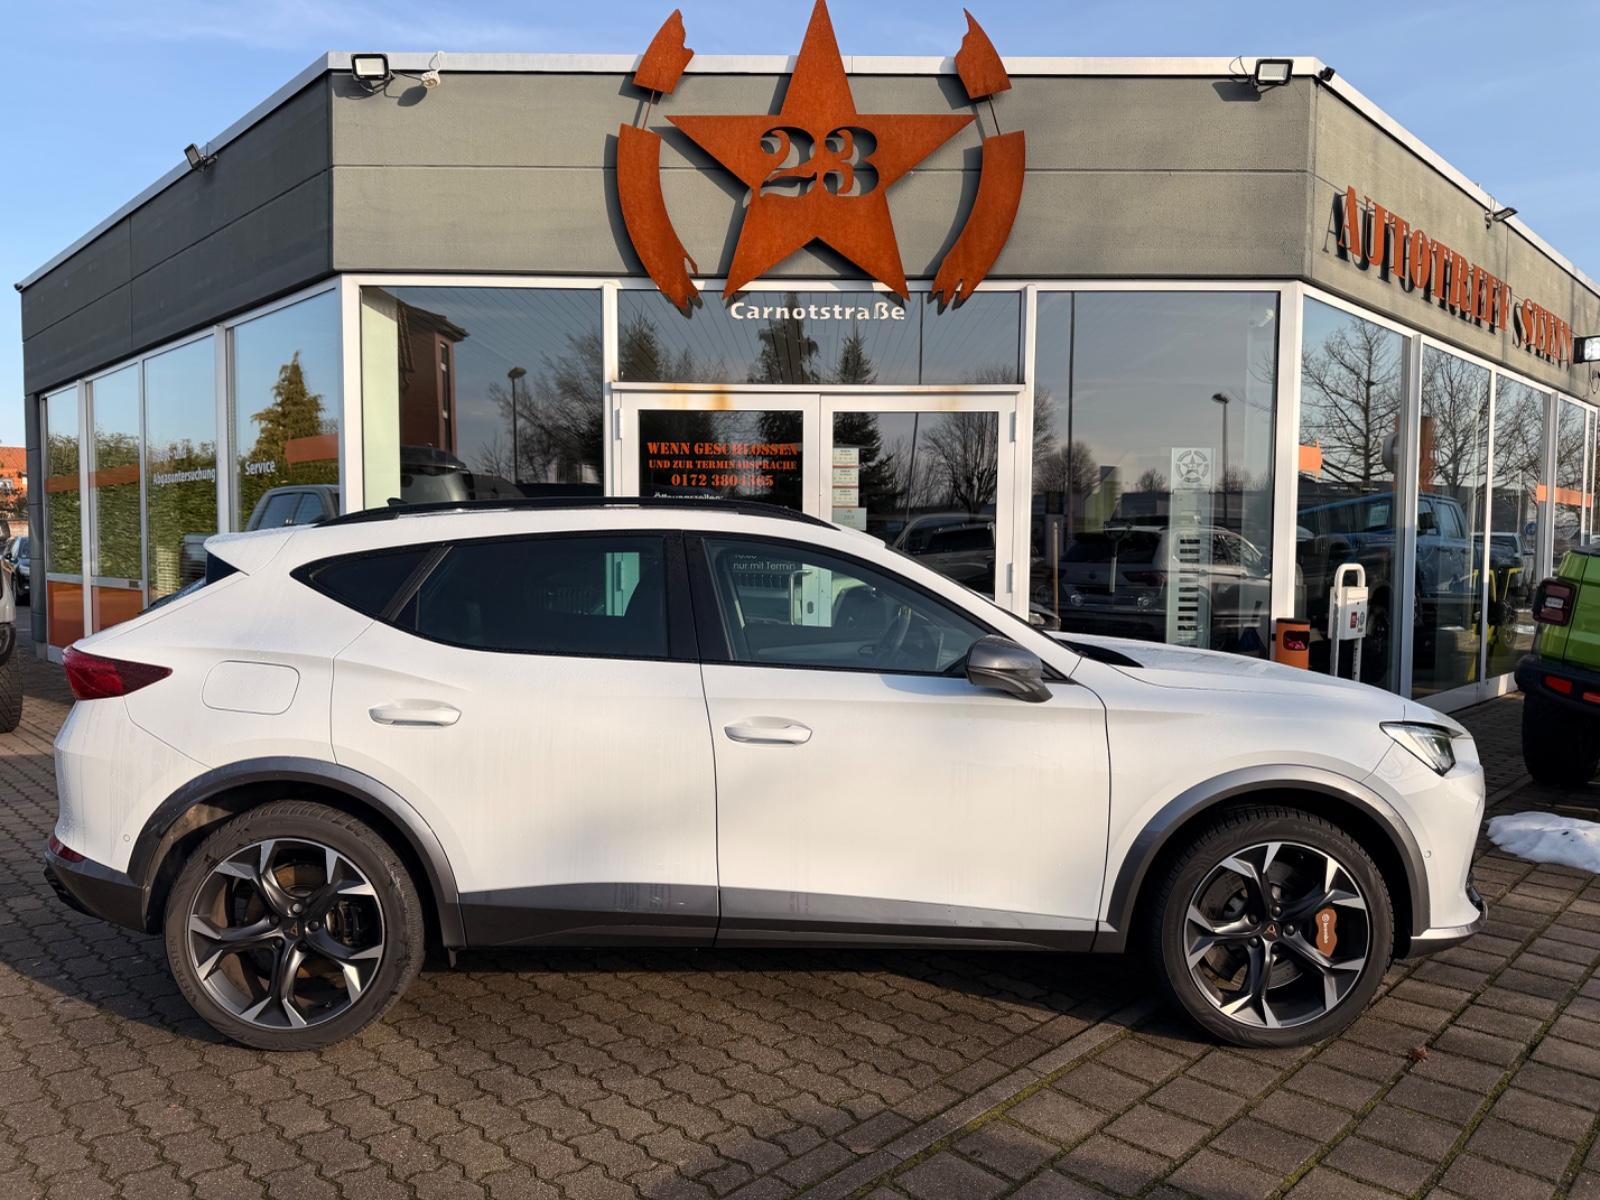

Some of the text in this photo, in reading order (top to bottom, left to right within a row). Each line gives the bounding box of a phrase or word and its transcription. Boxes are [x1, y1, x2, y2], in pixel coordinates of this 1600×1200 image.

[759, 125, 880, 198] 23
[729, 301, 906, 321] Carnotstraße
[647, 443, 690, 456] WENN
[244, 460, 277, 476] Service
[648, 459, 671, 470] UND
[672, 459, 693, 470] ZUR
[670, 473, 708, 487] 0172
